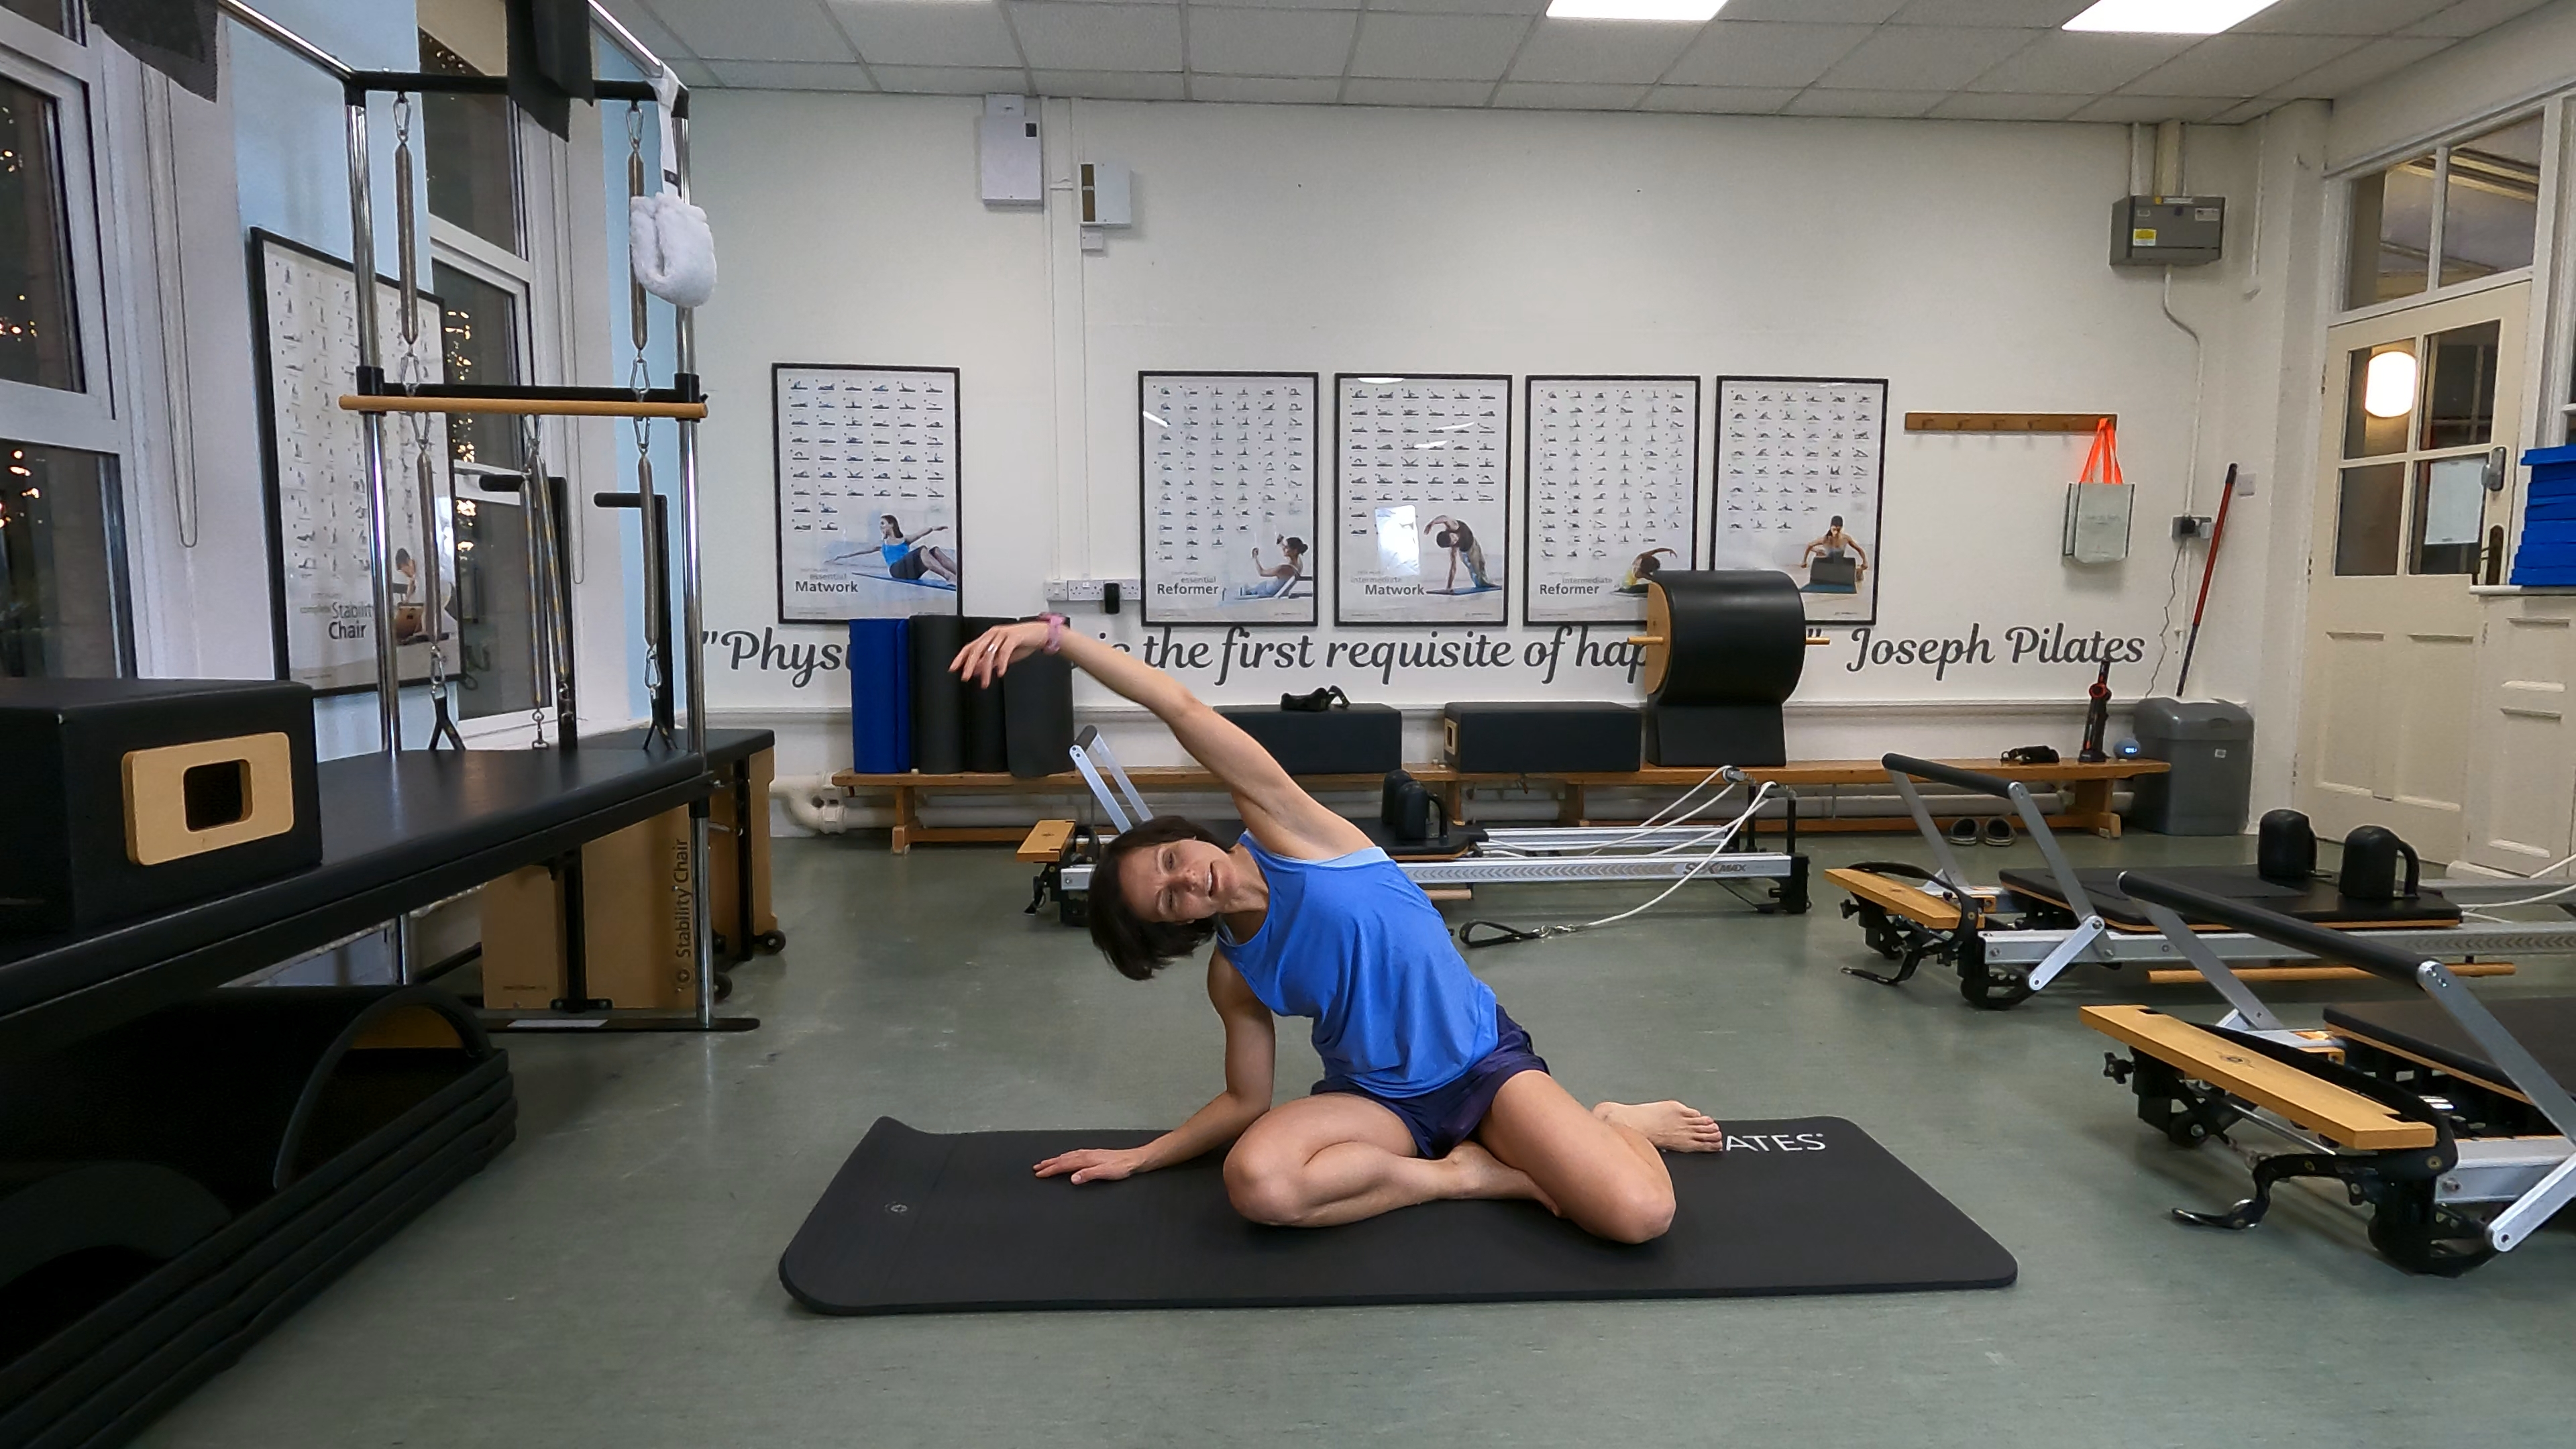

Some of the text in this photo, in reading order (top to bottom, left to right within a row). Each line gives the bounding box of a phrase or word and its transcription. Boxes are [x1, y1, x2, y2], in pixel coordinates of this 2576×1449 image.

[795, 580, 859, 592] Matwork
[1157, 582, 1219, 594] Reformer
[1364, 584, 1424, 595] Matwork
[1540, 583, 1599, 594] Reformer
[328, 621, 367, 640] Chair
[1142, 627, 1212, 668] the
[1214, 627, 1315, 686] first
[1326, 631, 1515, 685] requisite
[1523, 625, 1572, 684] of
[1576, 625, 1647, 684] hap
[1847, 623, 1996, 681] Joseph
[2006, 623, 2145, 664] Pilates
[673, 839, 693, 959] Stability Chair
[1726, 1133, 1825, 1151] ATES
